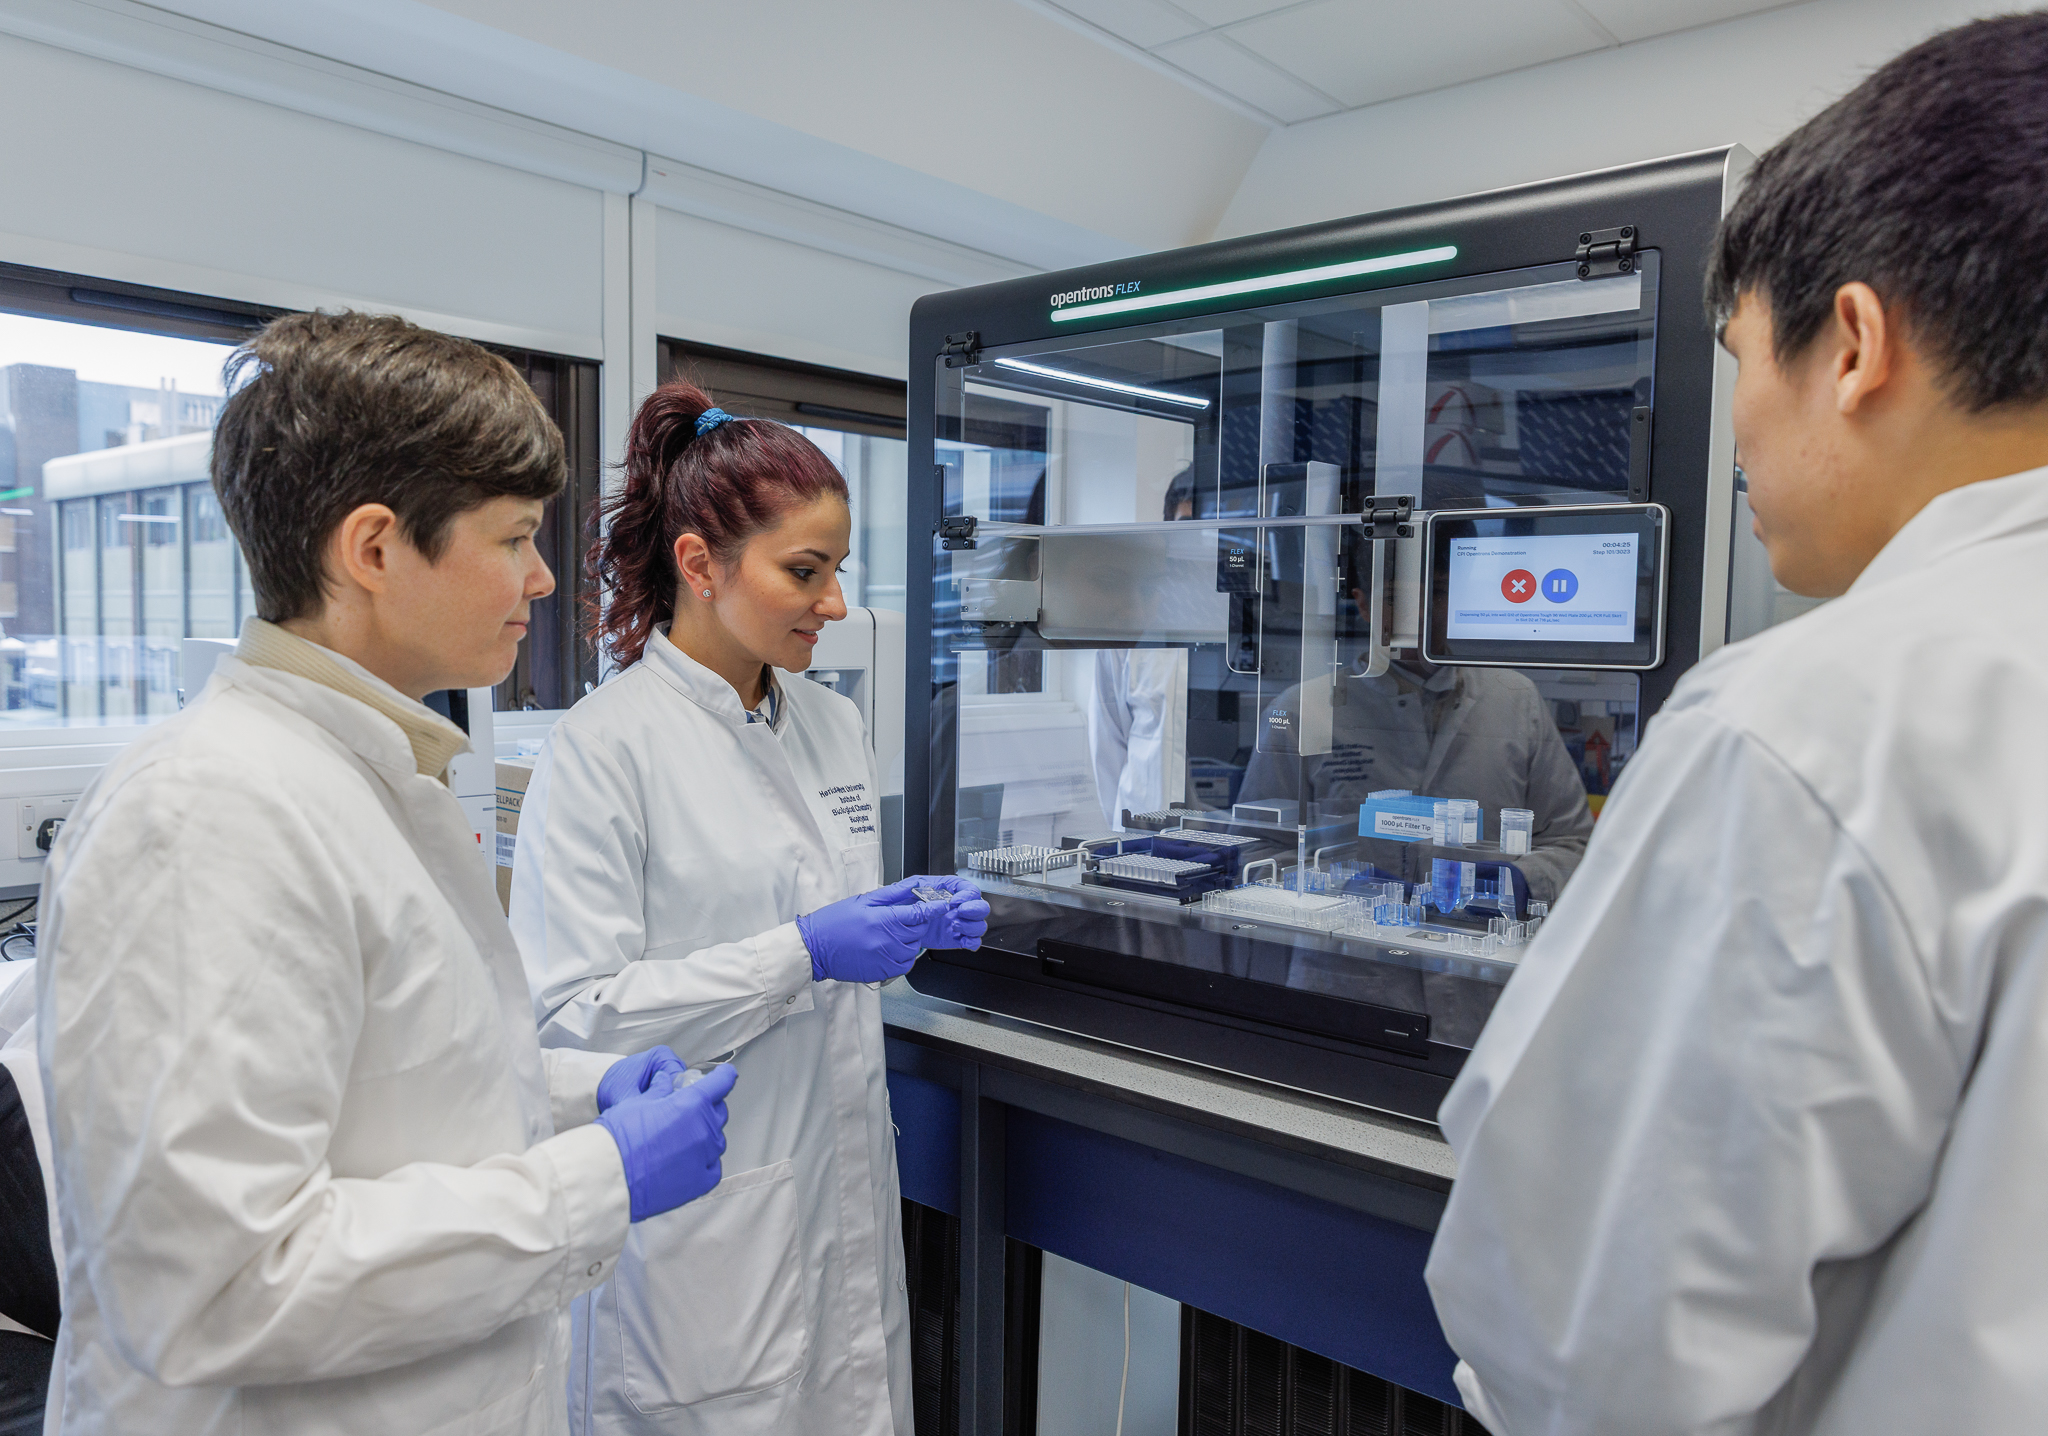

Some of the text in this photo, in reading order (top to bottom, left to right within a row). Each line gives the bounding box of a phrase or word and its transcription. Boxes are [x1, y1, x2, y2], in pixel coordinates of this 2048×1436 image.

[1050, 280, 1141, 308] opentrons FLEX
[496, 794, 520, 807] ELLPACK
